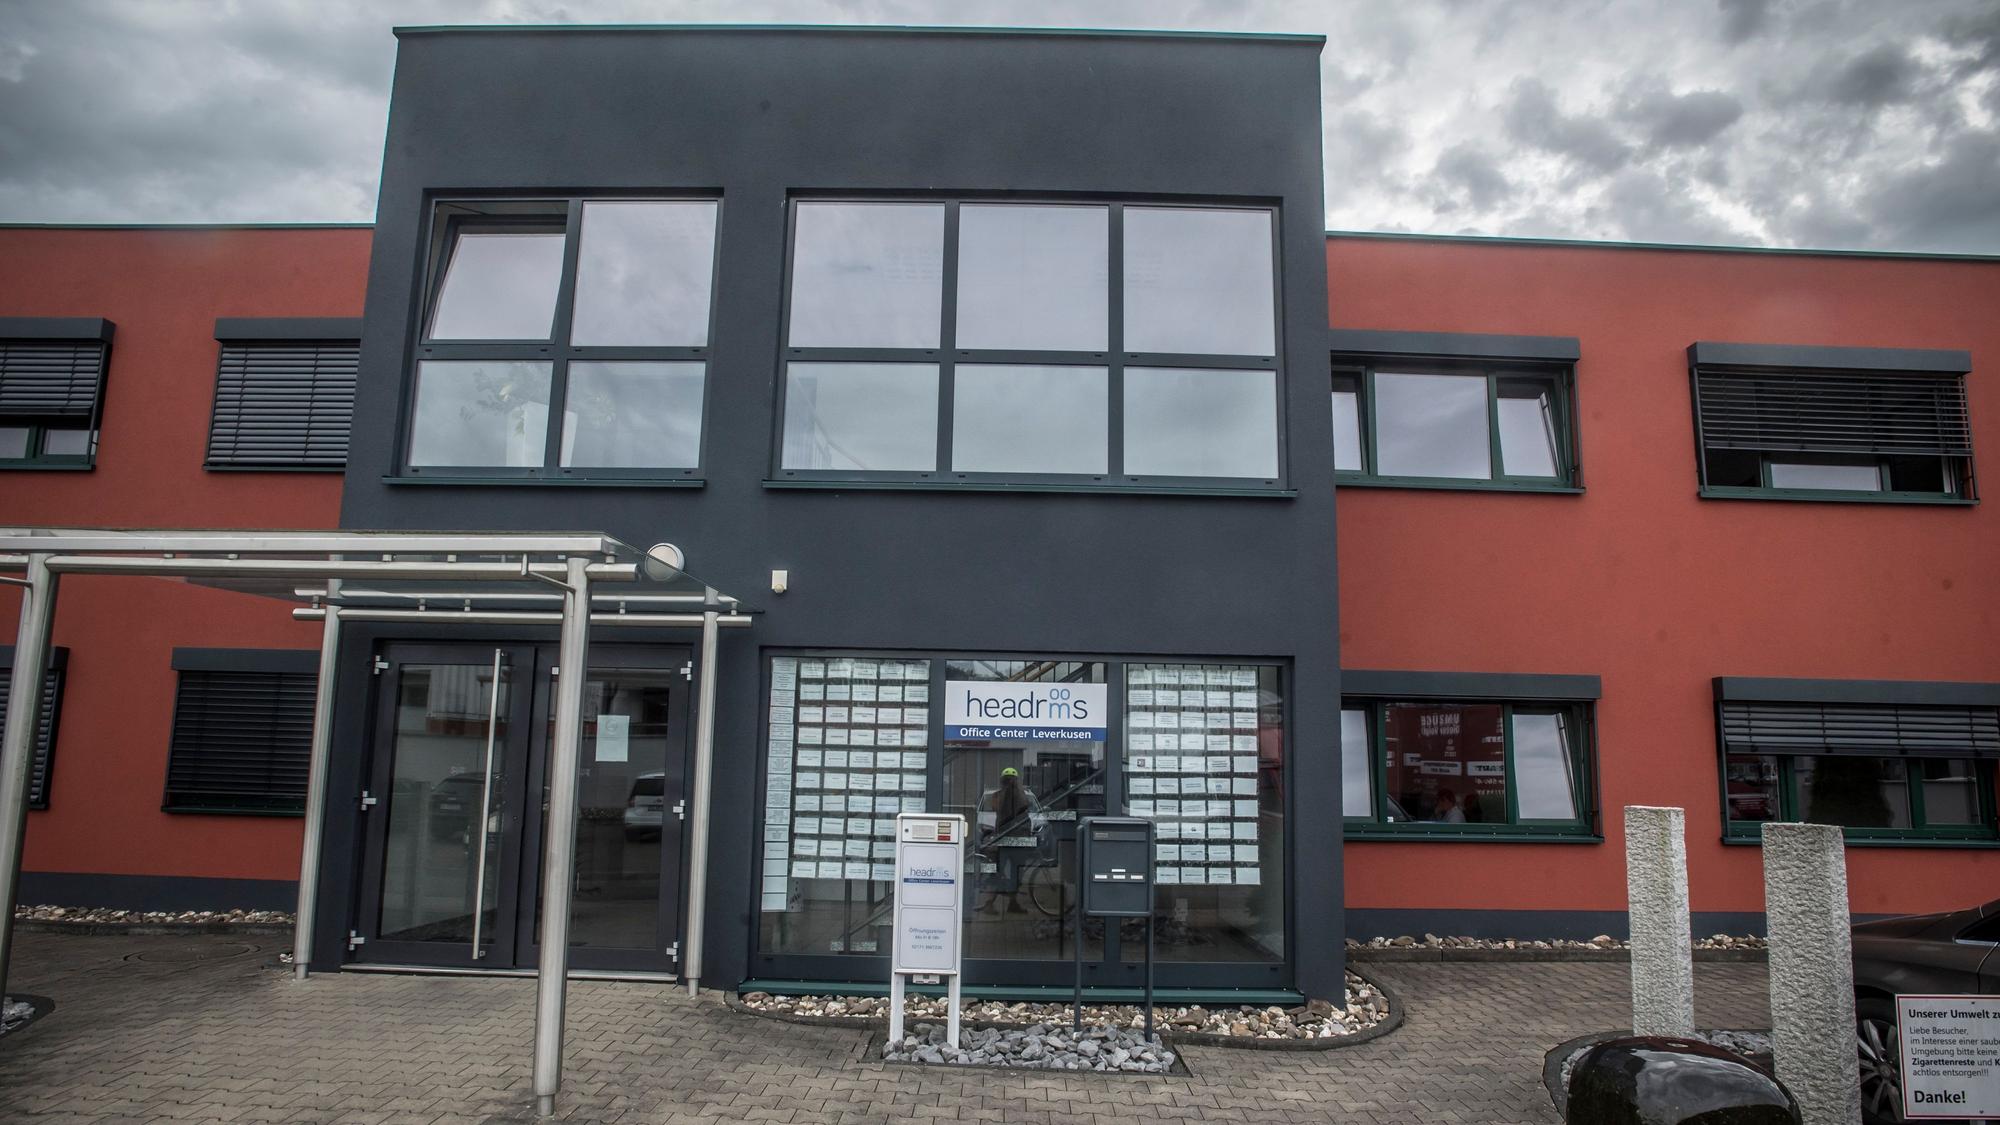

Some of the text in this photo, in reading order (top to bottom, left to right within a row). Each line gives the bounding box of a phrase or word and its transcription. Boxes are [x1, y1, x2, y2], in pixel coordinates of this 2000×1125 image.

[960, 728, 1092, 739] Office Center Leverkusen
[1908, 1009, 1948, 1019] Unserer
[1950, 1009, 1990, 1019] Umwelt
[1909, 1026, 1969, 1036] Liebe Besucher,
[1910, 1037, 1920, 1045] im
[1922, 1037, 1957, 1046] Interesse
[1958, 1037, 1979, 1046] einer
[1911, 1047, 1998, 1058] Umgebung bitte keine
[1912, 1057, 1975, 1068] Zigarettenreste
[1977, 1059, 1993, 1067] und
[1912, 1068, 1941, 1077] achtlos
[1914, 1089, 1967, 1104] Danke!
